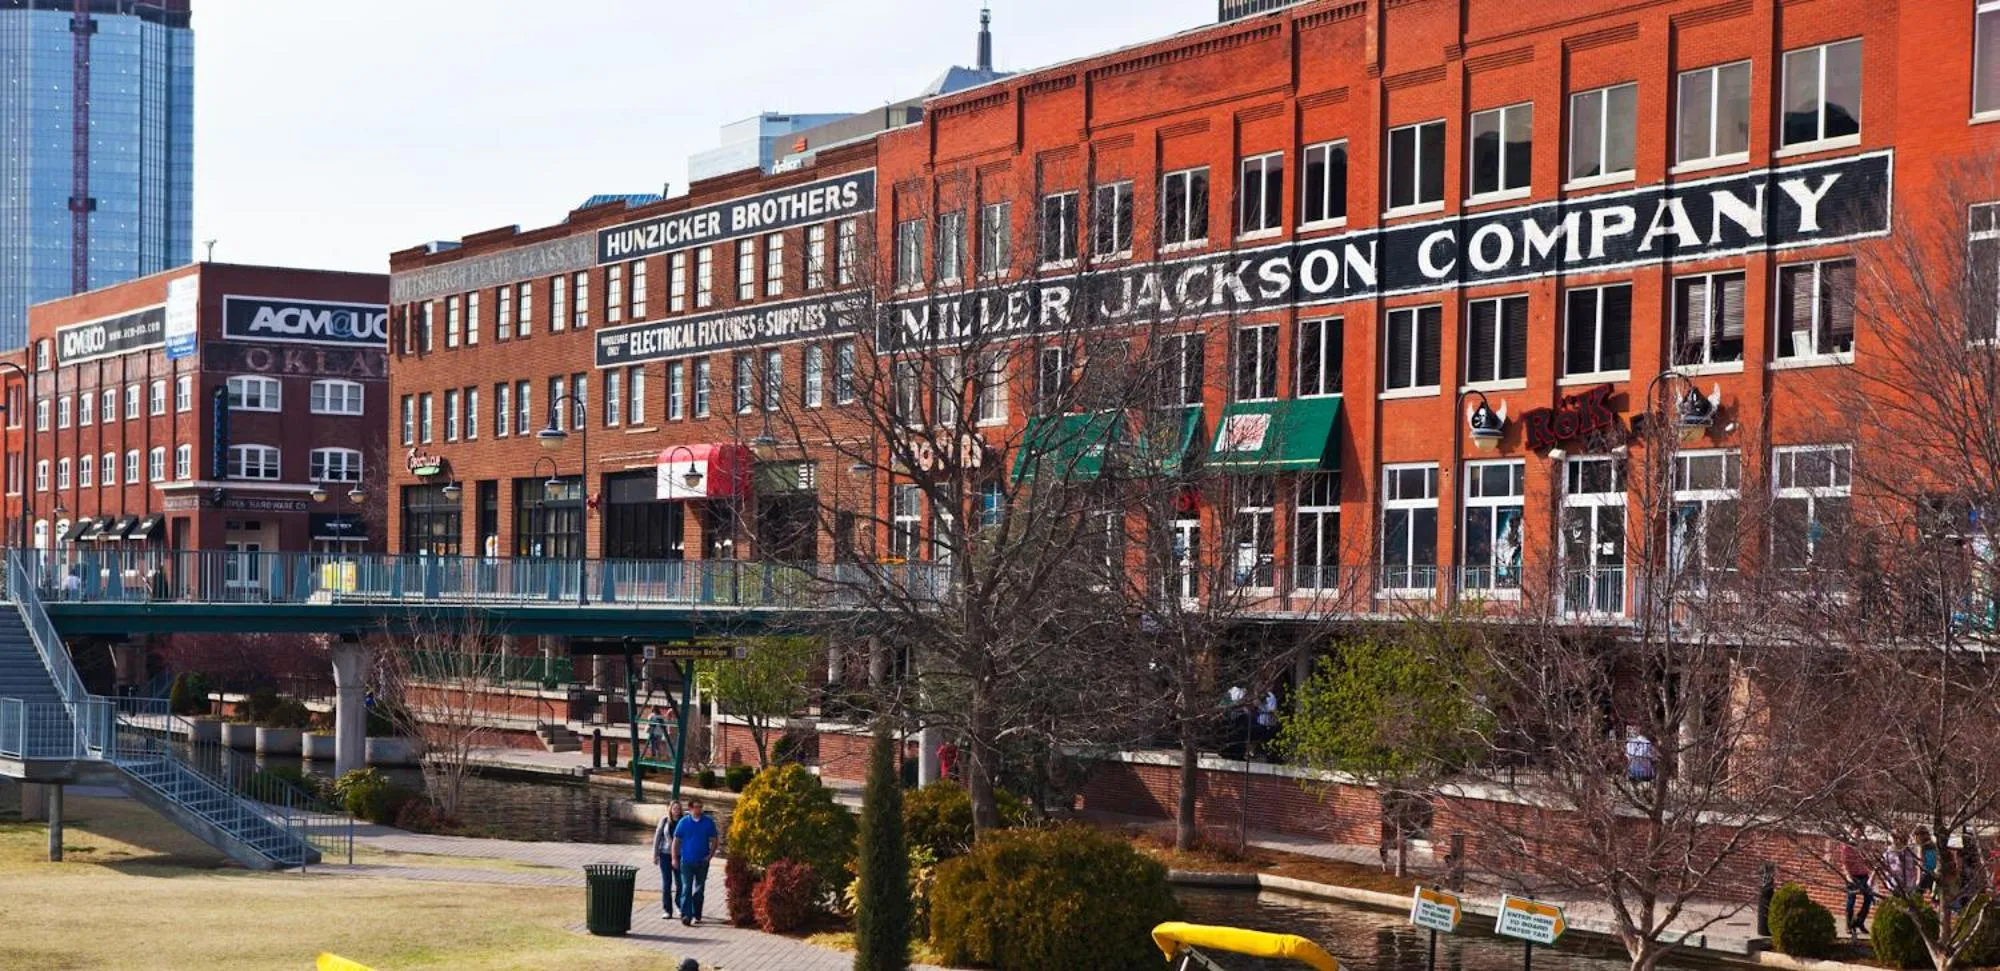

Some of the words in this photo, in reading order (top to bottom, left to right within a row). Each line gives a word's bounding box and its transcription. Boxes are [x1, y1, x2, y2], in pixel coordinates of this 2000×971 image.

[607, 211, 720, 257] HUNZICKER
[731, 181, 858, 232] BROTHERS
[901, 286, 1071, 345] MILLER
[1100, 240, 1378, 317] JACKSON
[1417, 173, 1843, 279] COMPANY
[394, 266, 466, 299] PITTSBURGH
[471, 257, 513, 284] PLATE
[519, 246, 566, 274] GLASS
[630, 322, 697, 355] ELECTRICAL
[698, 314, 756, 346] FIXTURES
[757, 317, 765, 333] &
[765, 303, 827, 337] SUPPLIES
[703, 647, 728, 657] Bridge
[1430, 911, 1450, 921] BOARD
[1436, 906, 1451, 914] HERE
[1418, 915, 1436, 924] WATER
[1438, 919, 1450, 928] TAXI
[1507, 911, 1532, 921] ENTER
[1533, 916, 1553, 925] HERE
[1506, 926, 1532, 936] WATER
[1532, 930, 1549, 939] TAXI
[1521, 921, 1548, 931] BOARD
